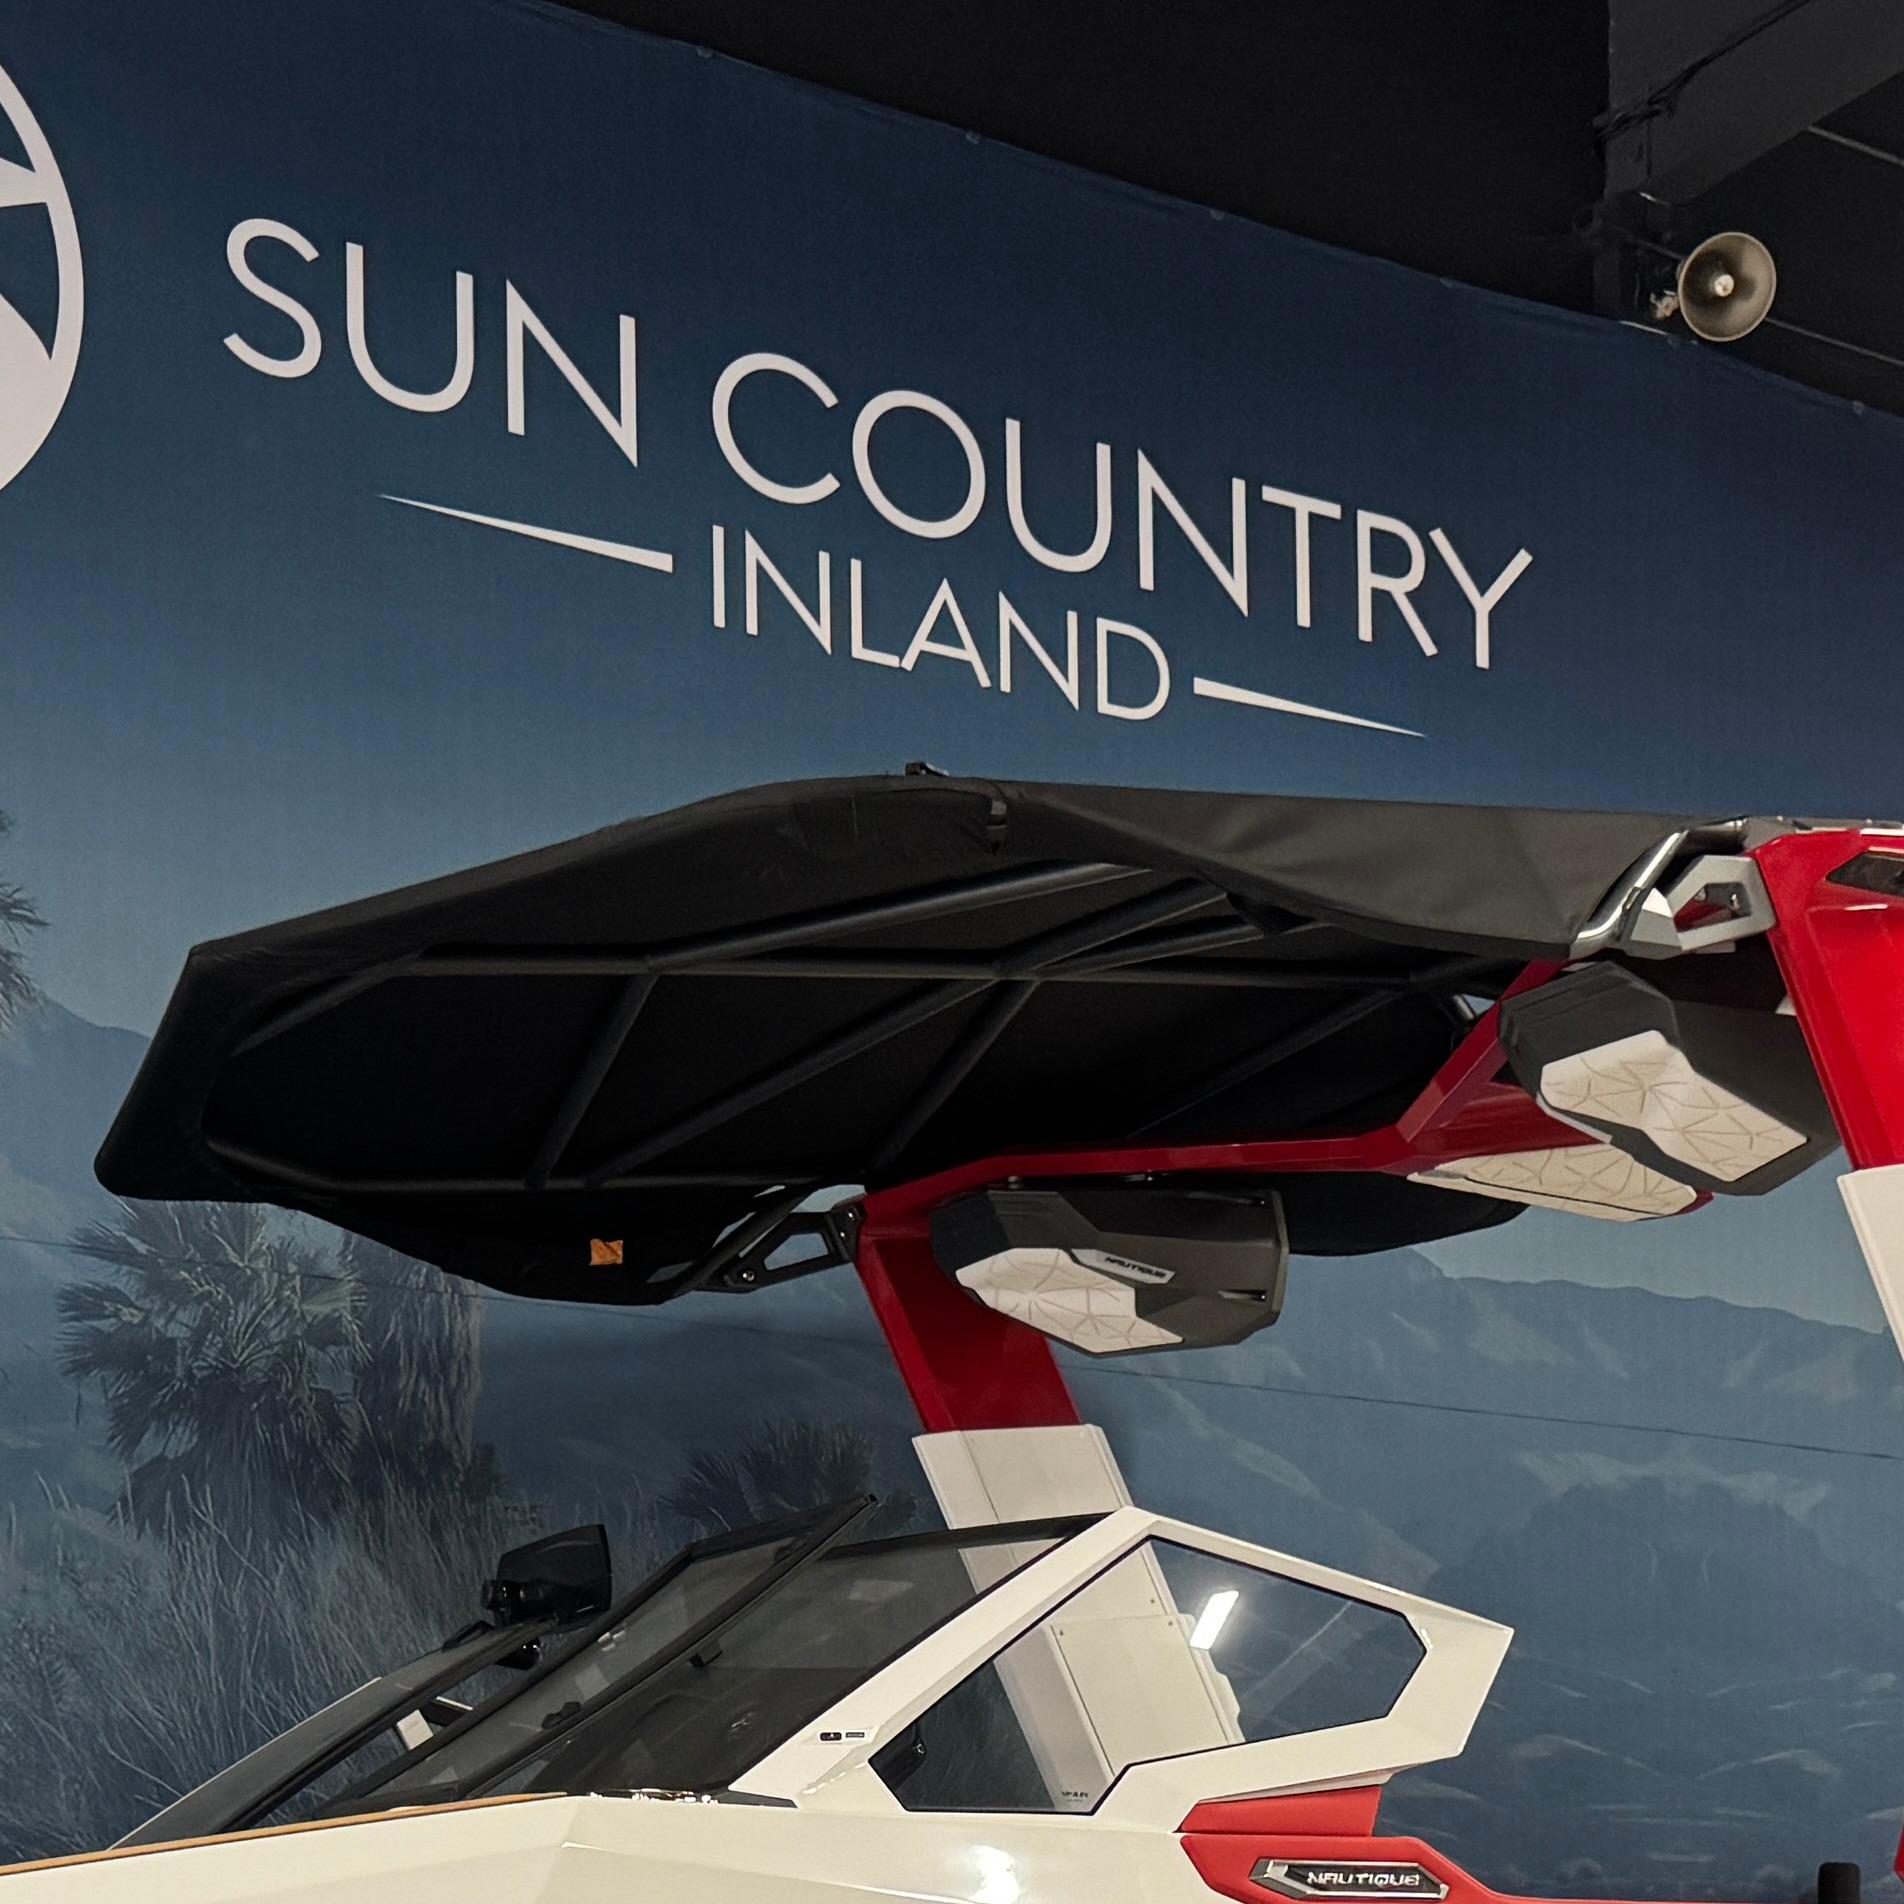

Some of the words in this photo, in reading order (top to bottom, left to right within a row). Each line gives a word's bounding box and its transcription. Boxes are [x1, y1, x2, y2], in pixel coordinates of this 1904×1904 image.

[222, 217, 639, 469] SUN
[711, 351, 1534, 670] COUNTRY
[711, 523, 1171, 721] INLAND
[1307, 1871, 1420, 1887] NAUTIQUE
